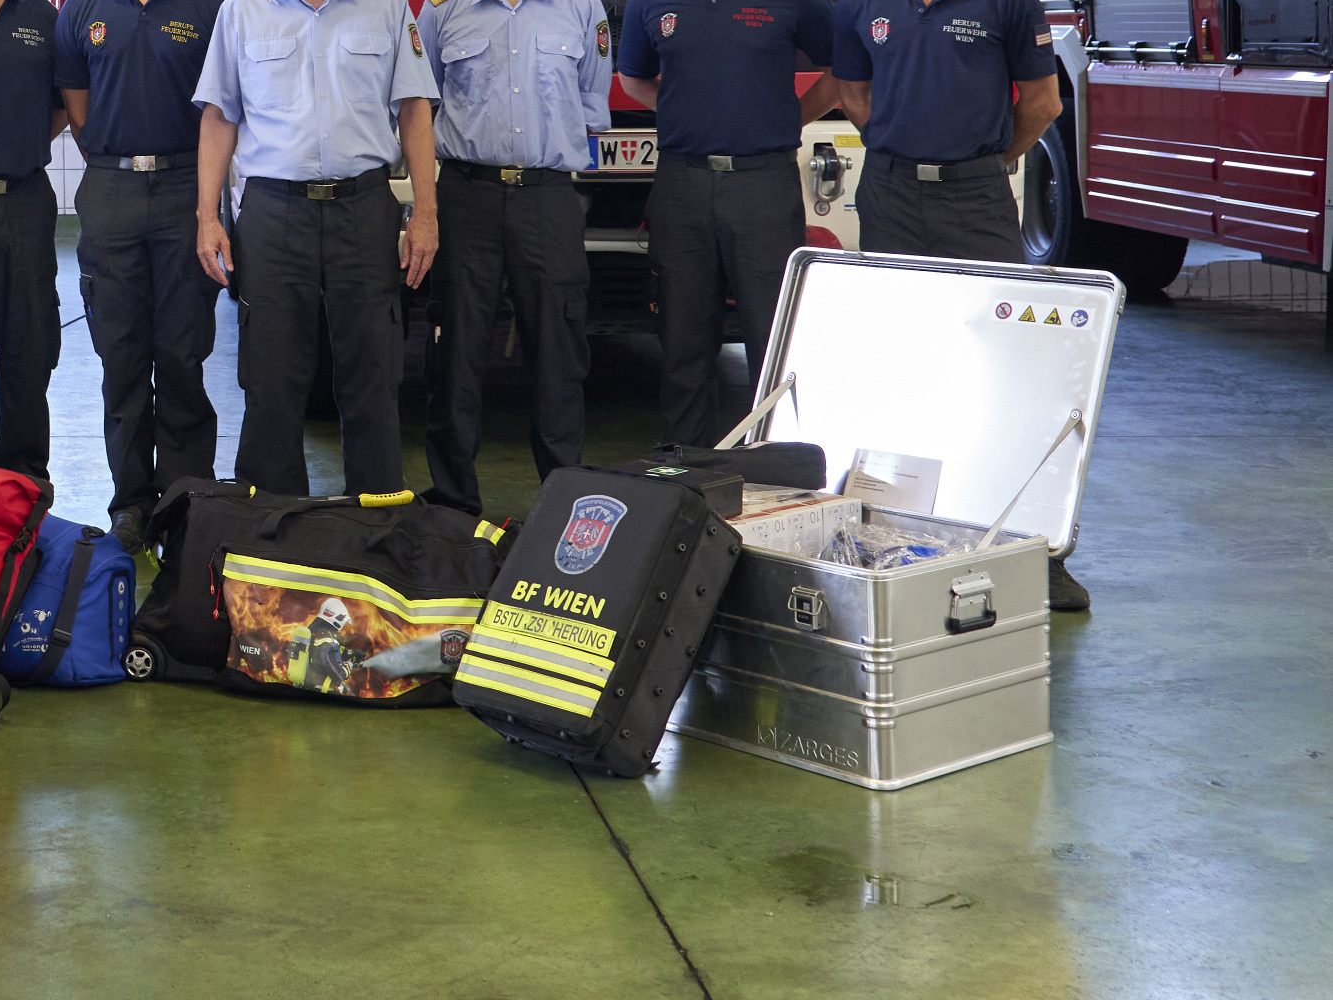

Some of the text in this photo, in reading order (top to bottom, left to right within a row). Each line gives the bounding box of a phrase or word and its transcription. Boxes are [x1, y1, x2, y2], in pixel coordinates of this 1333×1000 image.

[169, 20, 195, 31] BERUFS
[951, 18, 981, 28] BERUFS
[160, 25, 200, 39] FEUERWEHR
[942, 25, 988, 38] FEUERWEHR
[955, 34, 974, 43] WIEN
[600, 140, 654, 166] W 2
[511, 580, 606, 619] BF WIEN
[239, 644, 261, 656] WIEN
[780, 733, 859, 768] ZARGES
